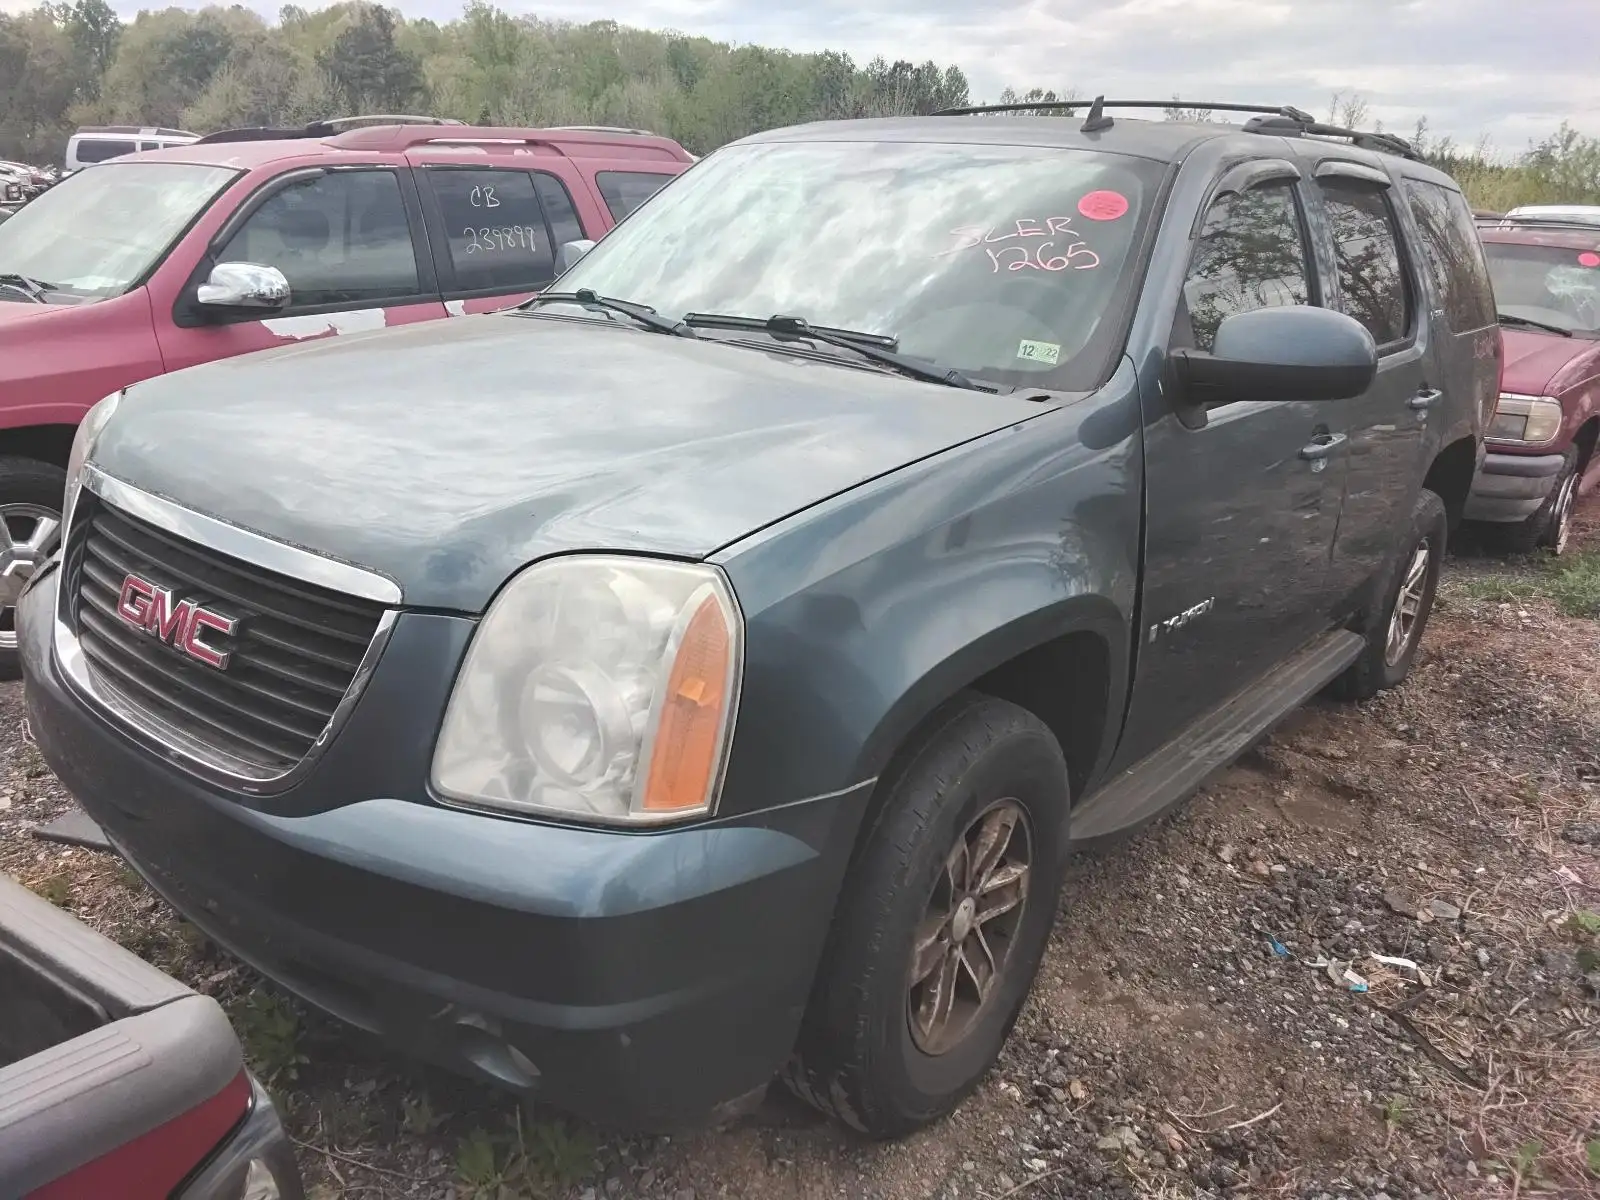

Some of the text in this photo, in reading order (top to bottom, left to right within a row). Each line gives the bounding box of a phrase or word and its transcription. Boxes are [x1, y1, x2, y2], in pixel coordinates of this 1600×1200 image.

[470, 185, 500, 207] CB
[986, 241, 1100, 273] 1265
[1022, 344, 1035, 357] 12
[117, 573, 239, 670] GMC
